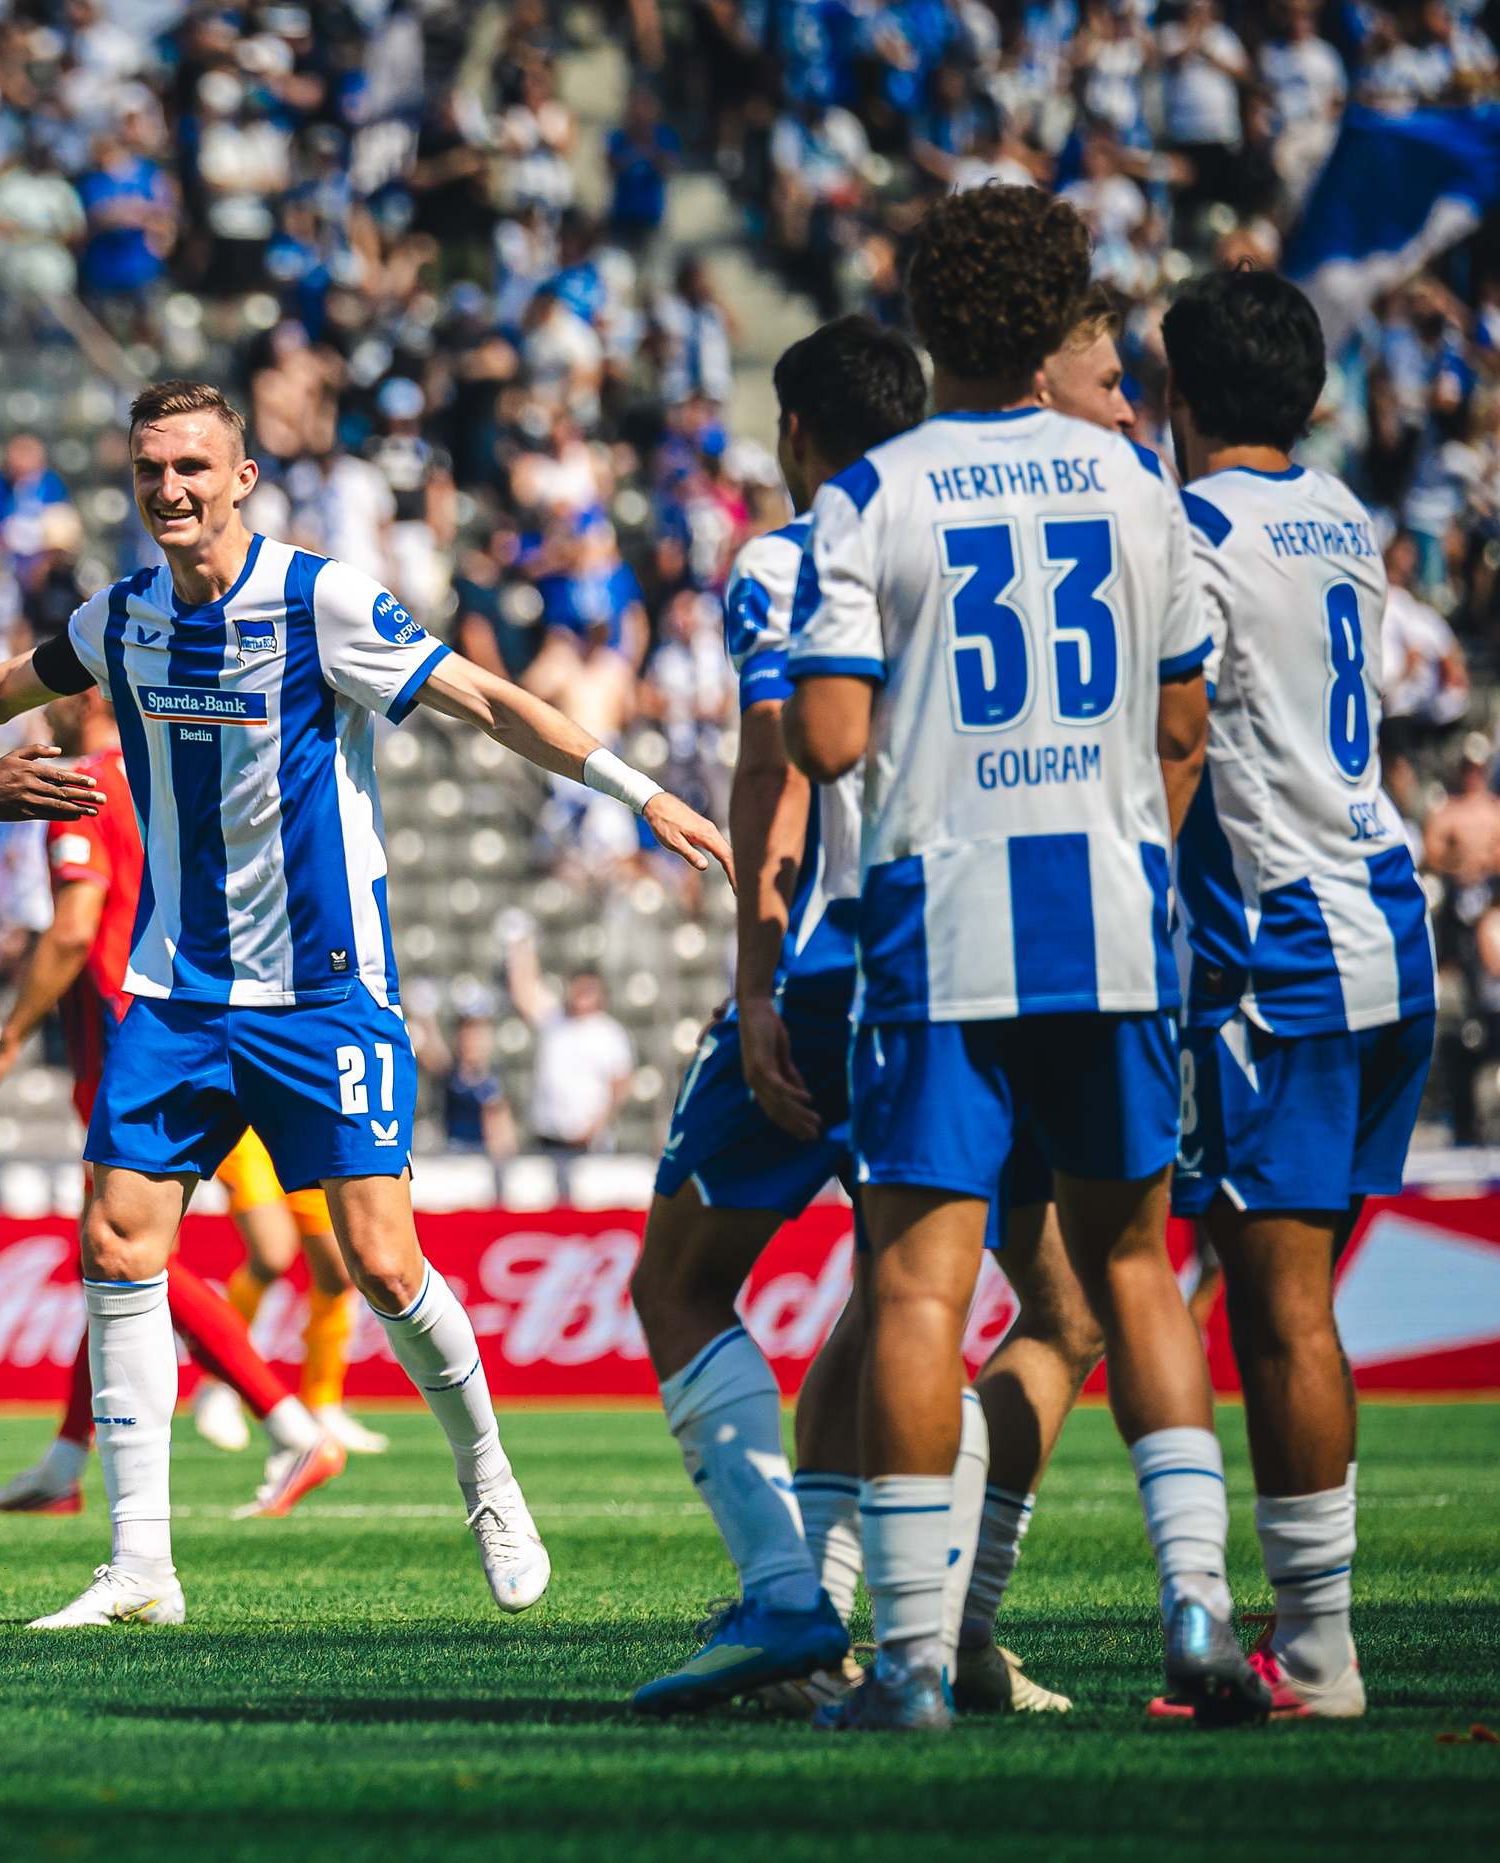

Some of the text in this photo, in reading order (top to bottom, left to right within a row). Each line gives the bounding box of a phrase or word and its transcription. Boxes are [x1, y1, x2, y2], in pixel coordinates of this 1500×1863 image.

[928, 458, 1106, 502] HERTHA BSC
[1262, 521, 1349, 557] HERTHA
[936, 513, 1123, 734] 33
[147, 691, 247, 714] Sparda-Bank
[1323, 577, 1374, 783] 8
[180, 728, 213, 742] Berlin
[977, 744, 1102, 790] GOURAM
[336, 1042, 394, 1115] 21
